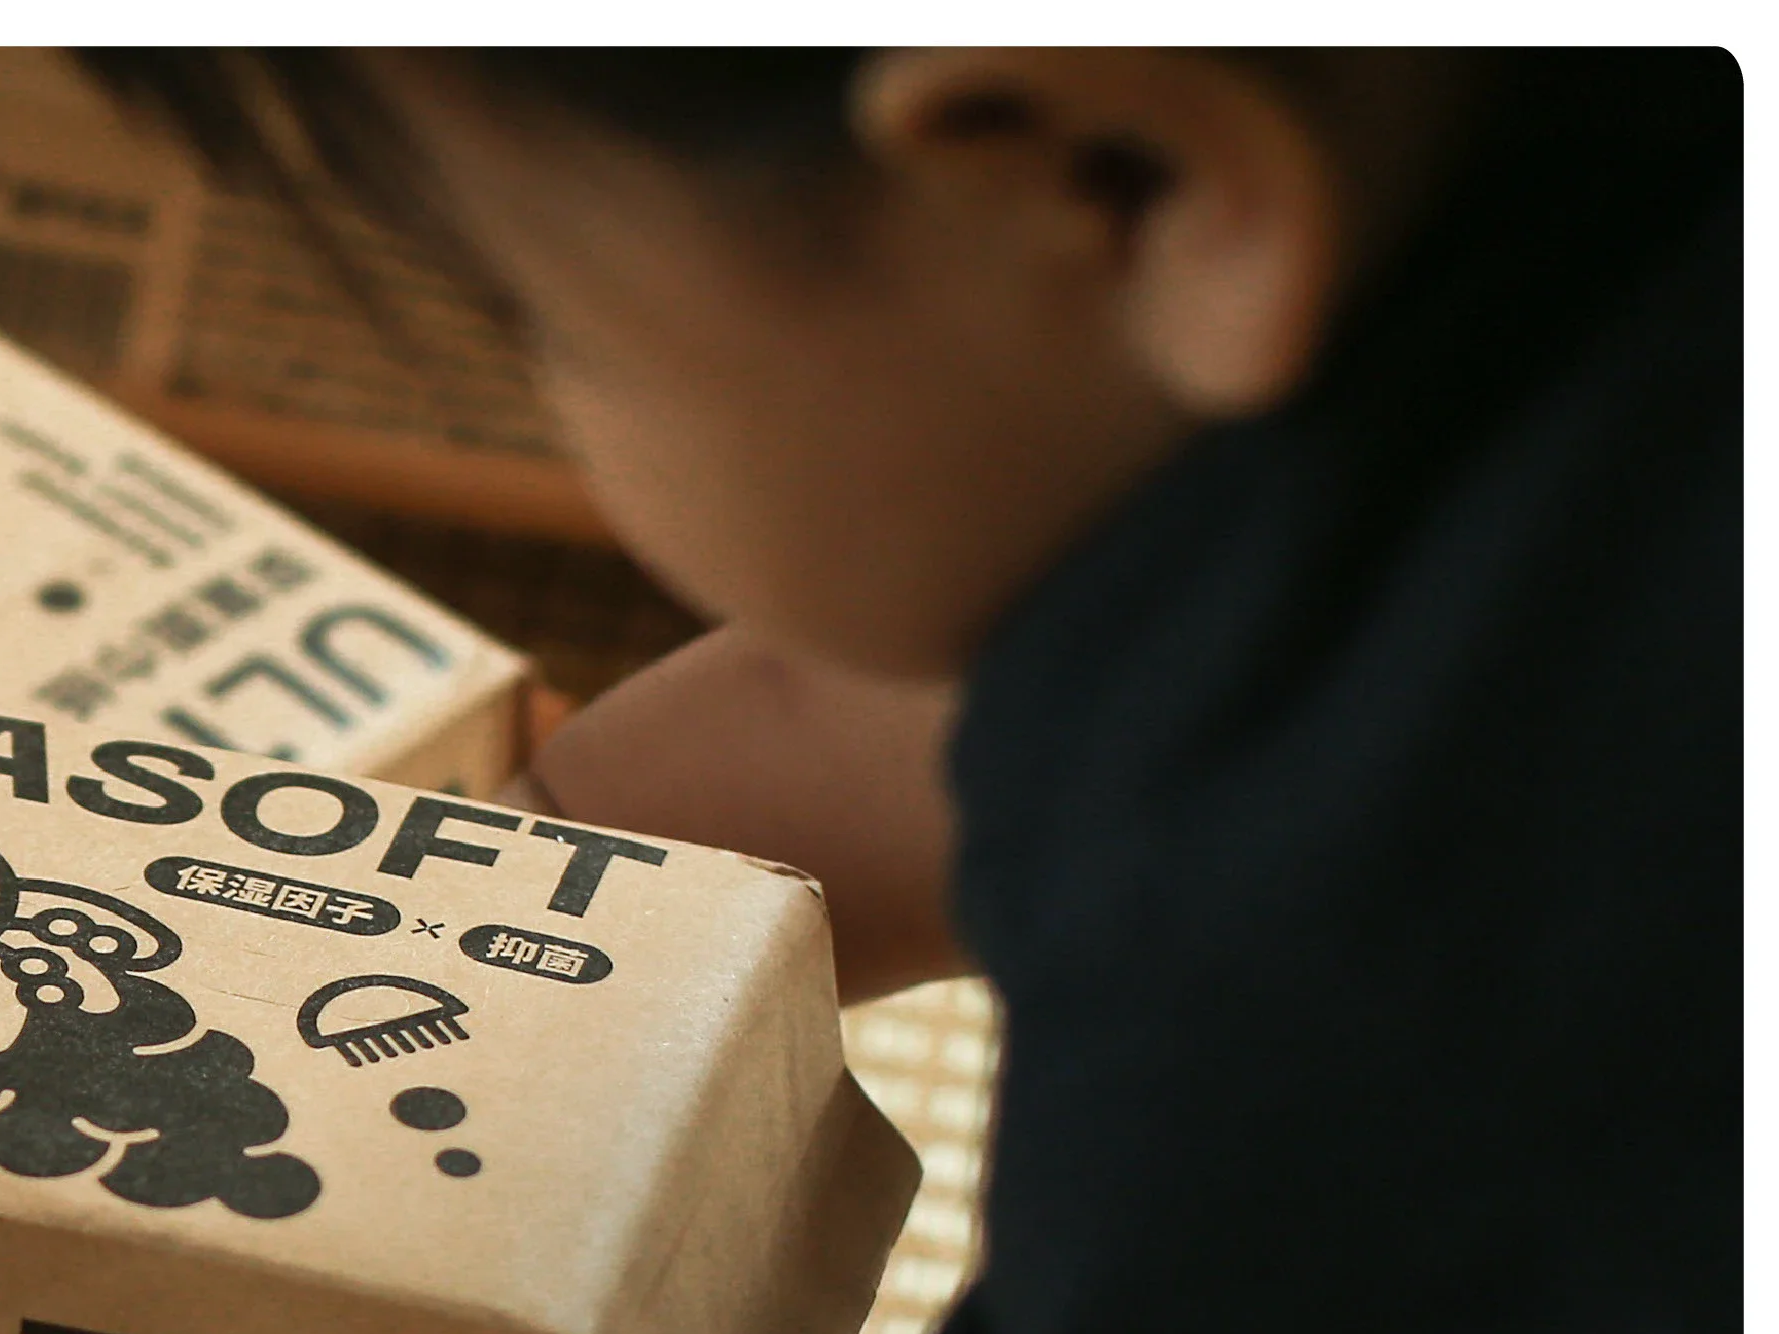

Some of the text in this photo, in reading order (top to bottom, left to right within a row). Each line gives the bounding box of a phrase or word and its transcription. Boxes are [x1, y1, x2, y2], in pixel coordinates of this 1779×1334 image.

[176, 864, 375, 926] 保湿因子
[485, 931, 589, 979] 抑菌
